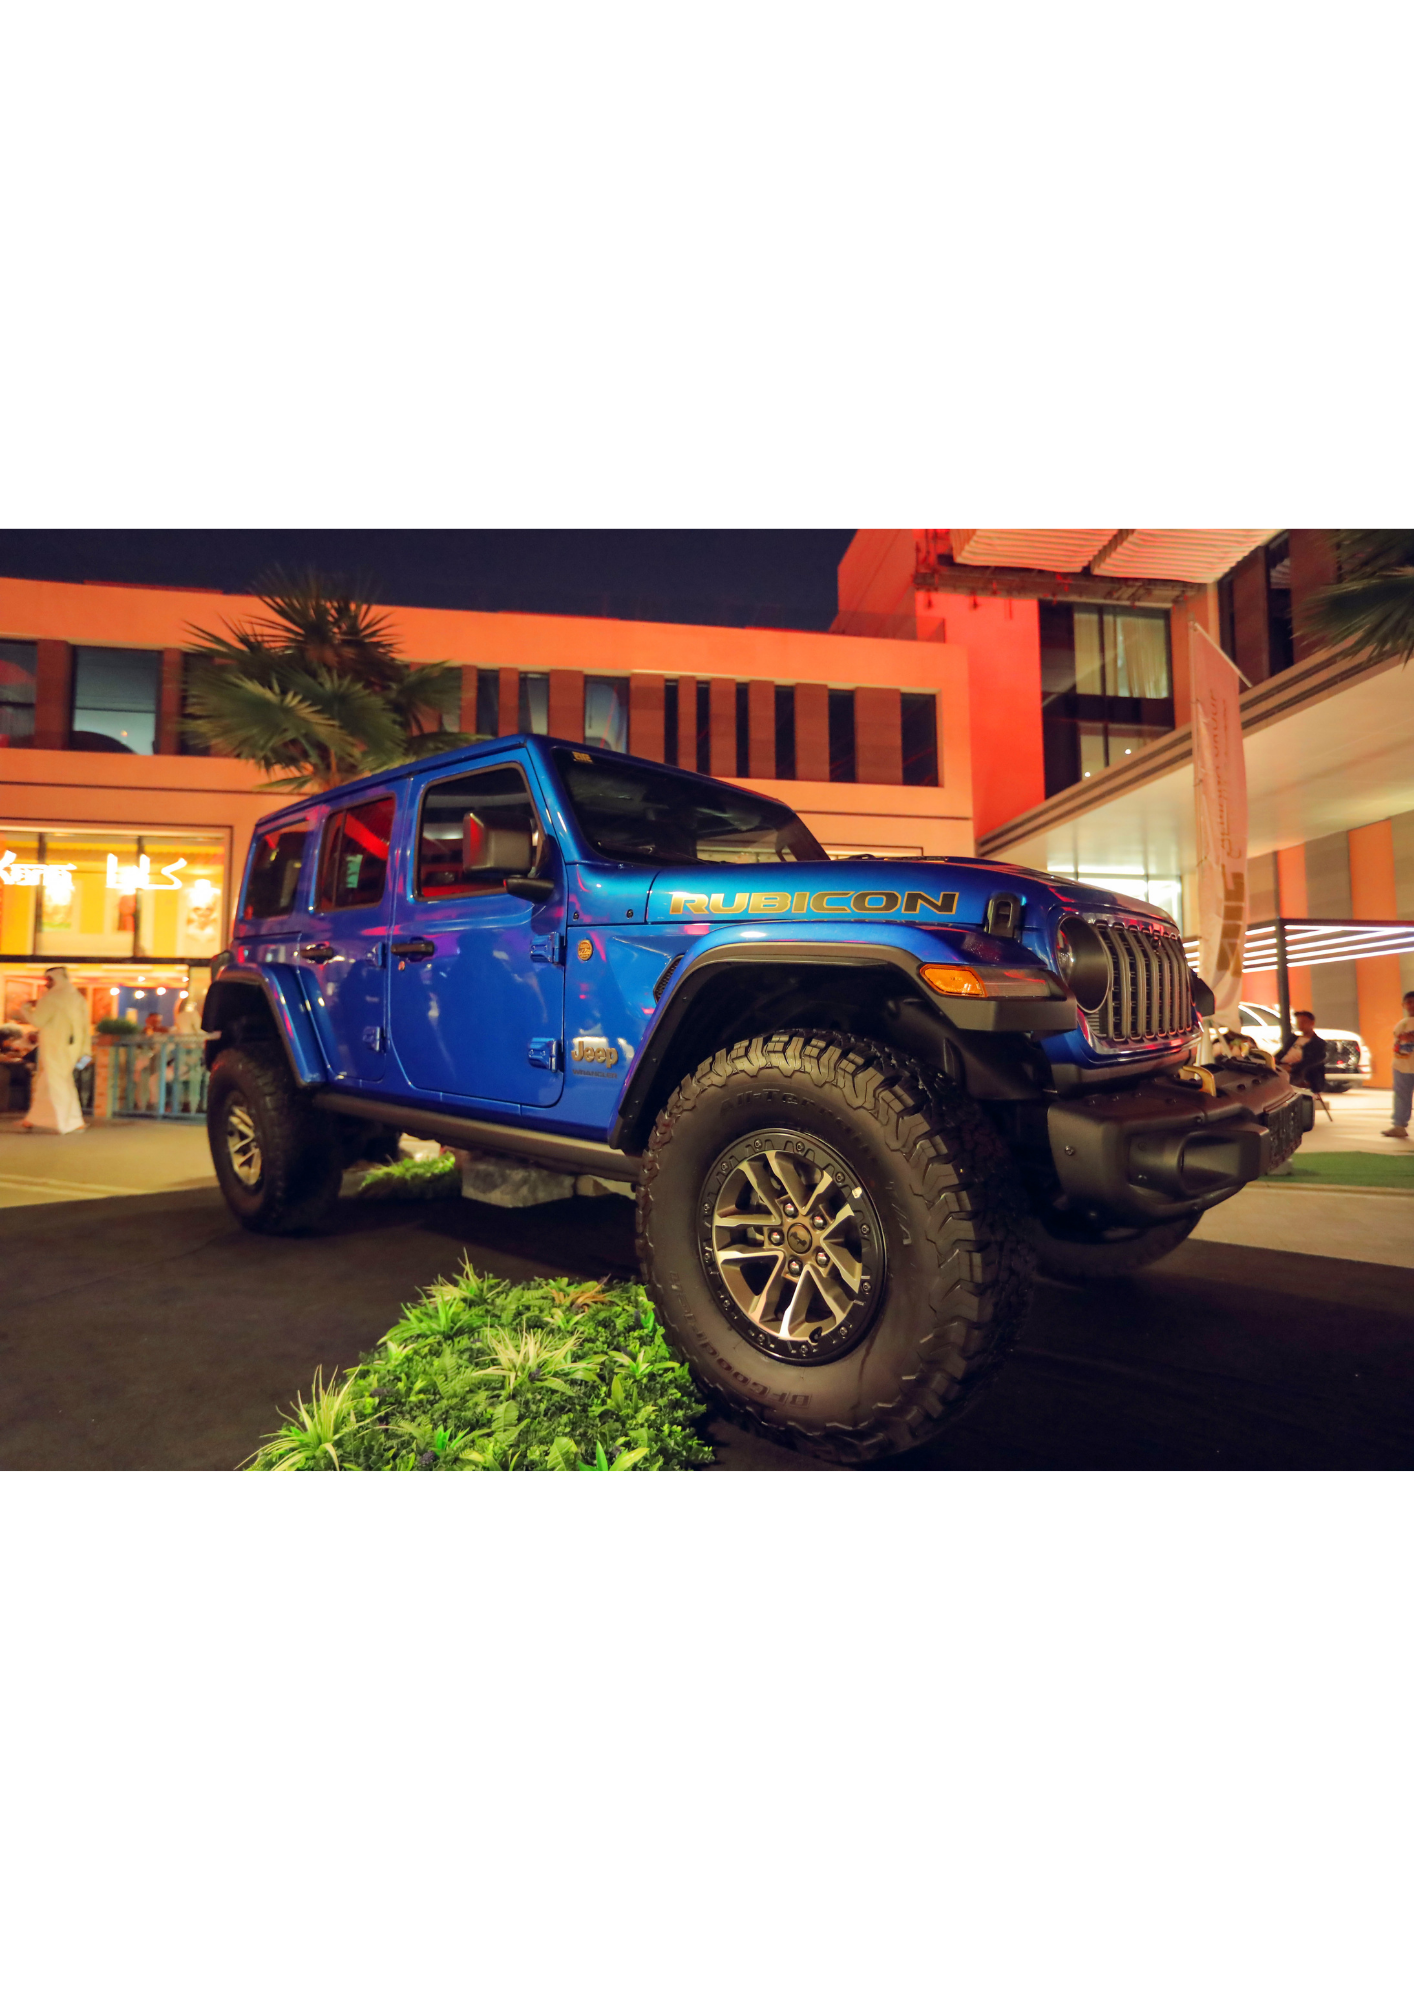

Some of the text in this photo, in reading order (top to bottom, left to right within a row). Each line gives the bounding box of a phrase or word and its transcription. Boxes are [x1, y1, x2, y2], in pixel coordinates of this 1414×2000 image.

[669, 891, 960, 915] RUBICON
[571, 1041, 618, 1068] Jeep
[572, 1069, 618, 1079] WRANGLER
